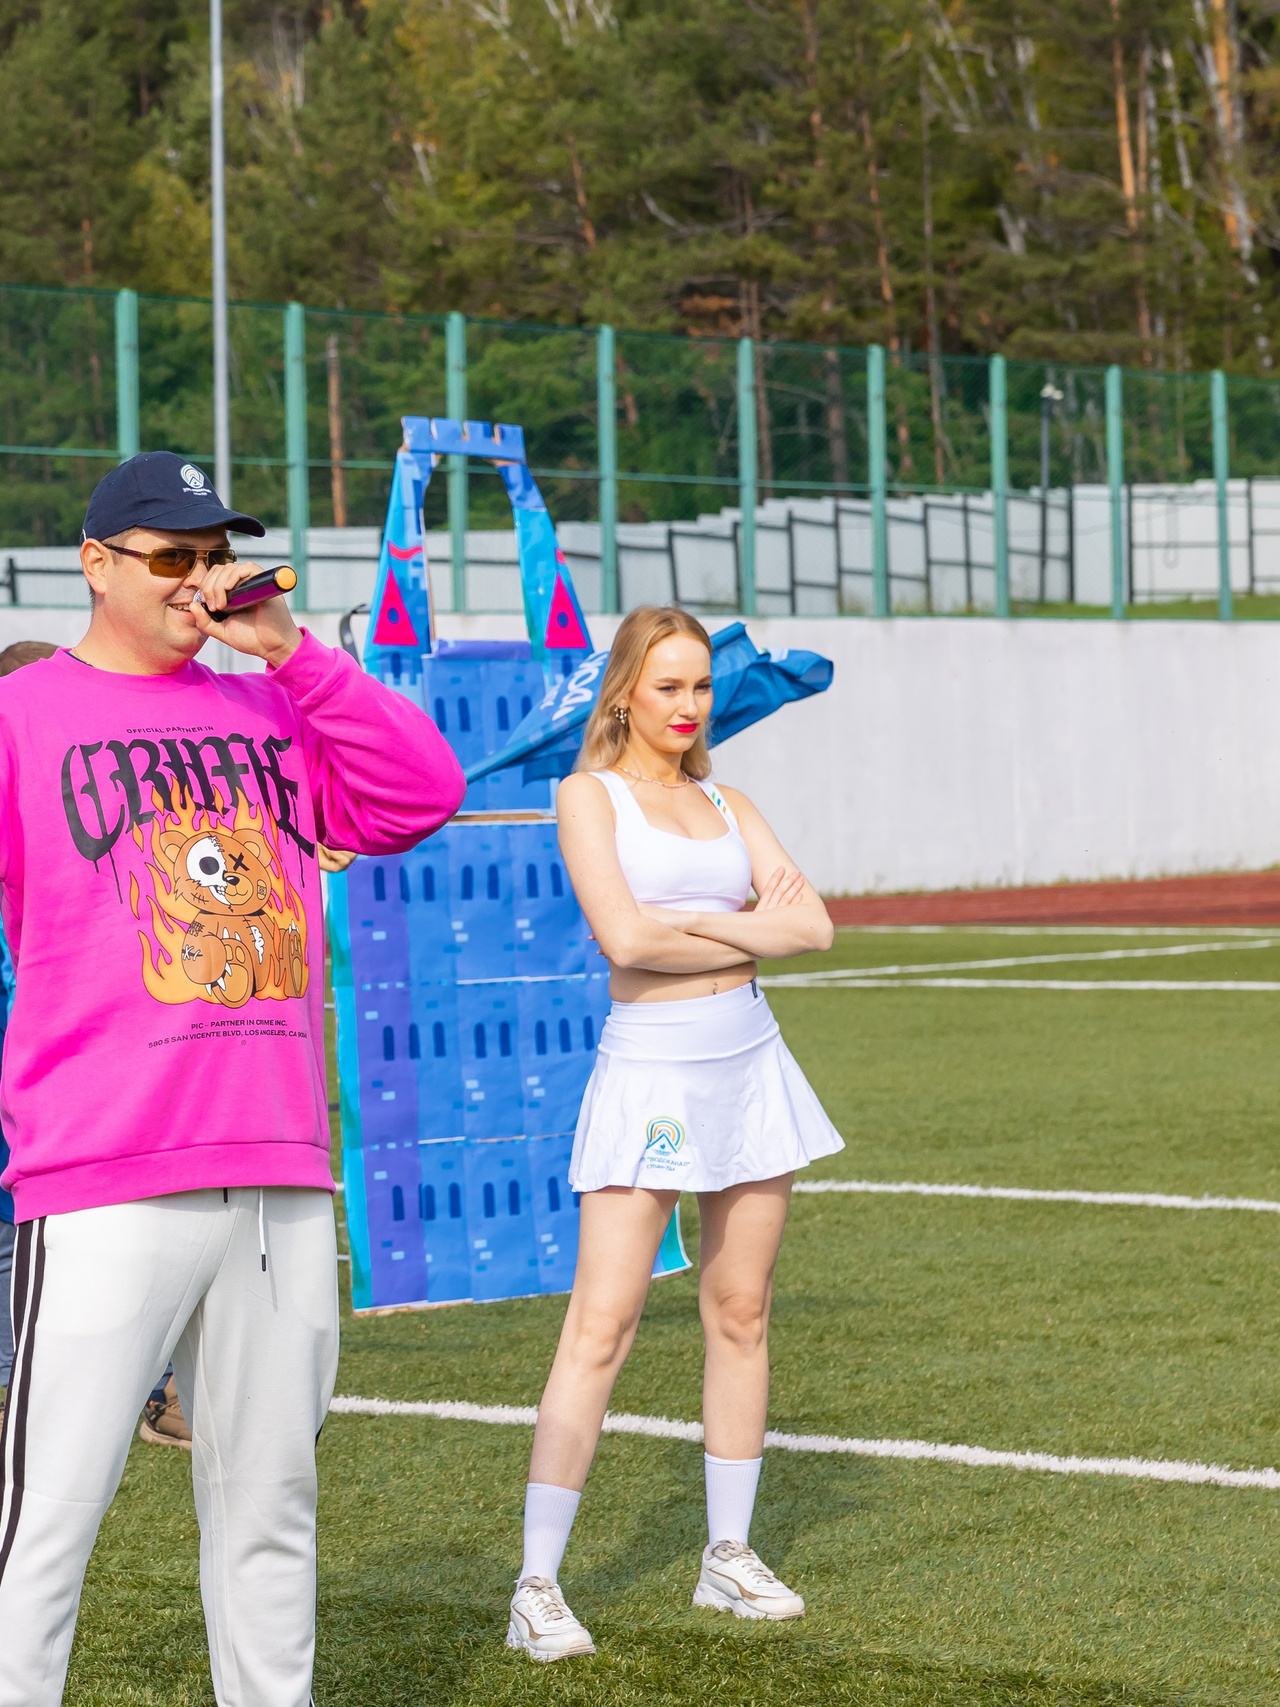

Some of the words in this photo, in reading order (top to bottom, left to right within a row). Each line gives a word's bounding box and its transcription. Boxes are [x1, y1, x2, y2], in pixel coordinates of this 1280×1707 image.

[191, 1022, 204, 1030] PIC
[210, 1019, 245, 1028] PARTNER
[170, 1034, 188, 1043] SAN
[189, 1031, 221, 1040] VICENTE
